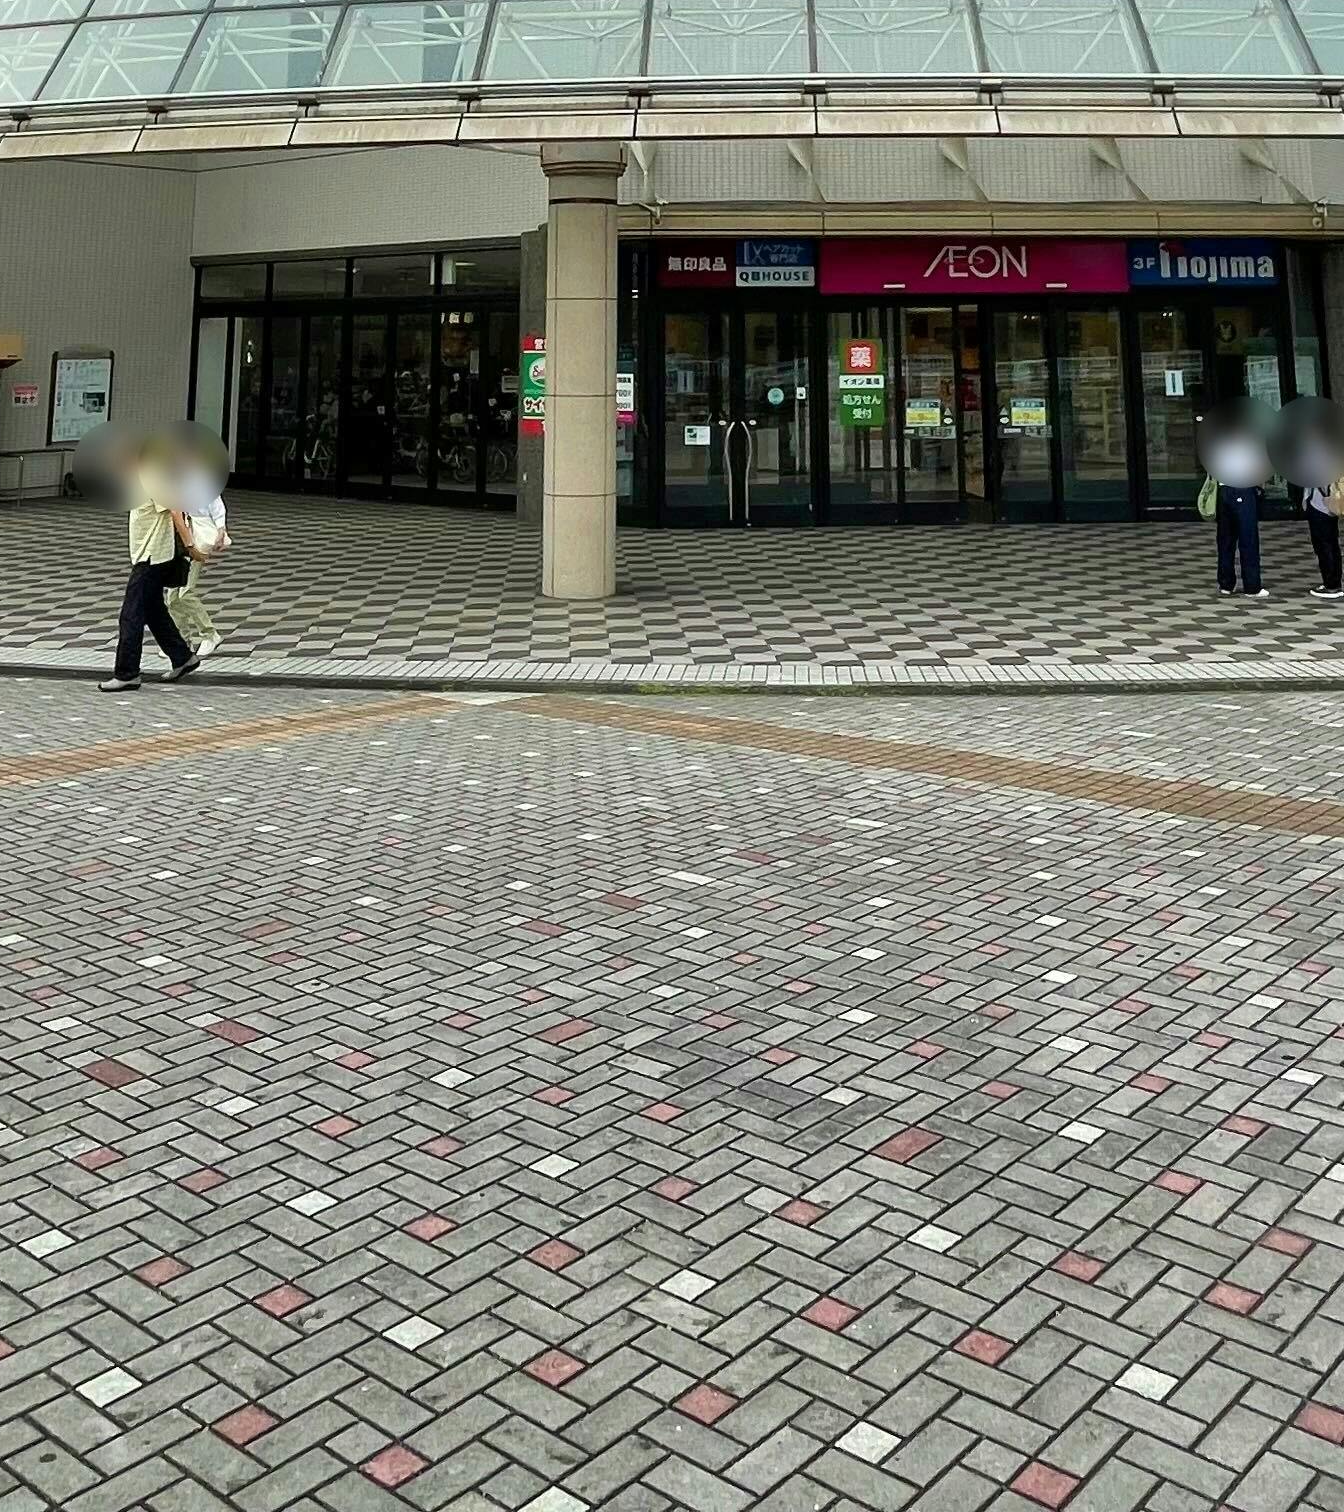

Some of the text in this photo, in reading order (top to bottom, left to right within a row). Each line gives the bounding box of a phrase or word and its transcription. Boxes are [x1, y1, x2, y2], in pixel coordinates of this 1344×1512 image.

[668, 256, 727, 271] 無印良品
[1133, 257, 1155, 269] 3F
[850, 347, 872, 368] 薬
[842, 394, 881, 405] 処方せん
[852, 408, 872, 419] 受付
